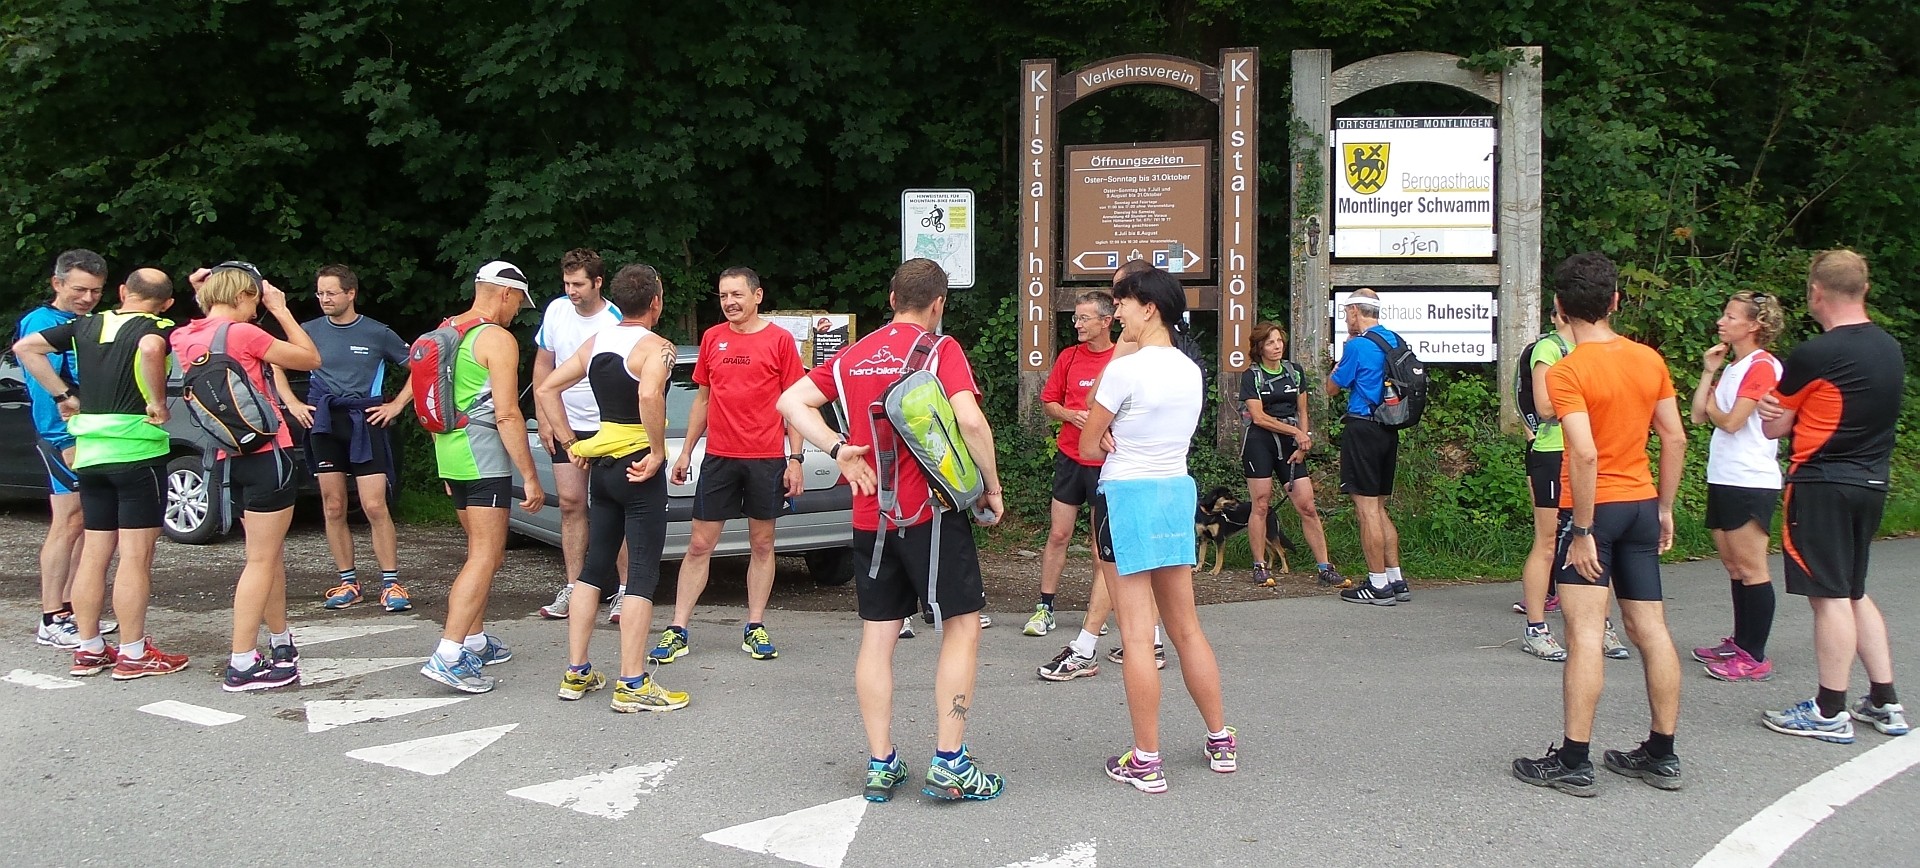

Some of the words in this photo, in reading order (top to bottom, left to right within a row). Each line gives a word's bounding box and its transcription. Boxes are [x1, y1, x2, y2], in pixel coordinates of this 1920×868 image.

[1081, 64, 1194, 87] Verkehrsverein
[1338, 119, 1419, 129] ORTSGEMEINDE
[1423, 118, 1491, 128] MONTLINGEN
[1090, 154, 1184, 168] Öffnungszeiten
[1084, 174, 1137, 184] Oster-Sonntag
[1138, 174, 1150, 182] bis
[1151, 173, 1191, 182] 31.Oktober
[1401, 172, 1490, 192] Berggasthaus
[1229, 58, 1249, 367] Kristallhöhle
[1338, 197, 1414, 217] Montlinger
[1417, 196, 1490, 213] Schwamm
[1029, 70, 1048, 367] Kristallhöhle
[1392, 235, 1439, 256] offen
[1107, 255, 1116, 266] P
[1156, 253, 1165, 264] P
[1427, 303, 1490, 320] Ruhesitz
[1419, 341, 1485, 357] Ruhetag
